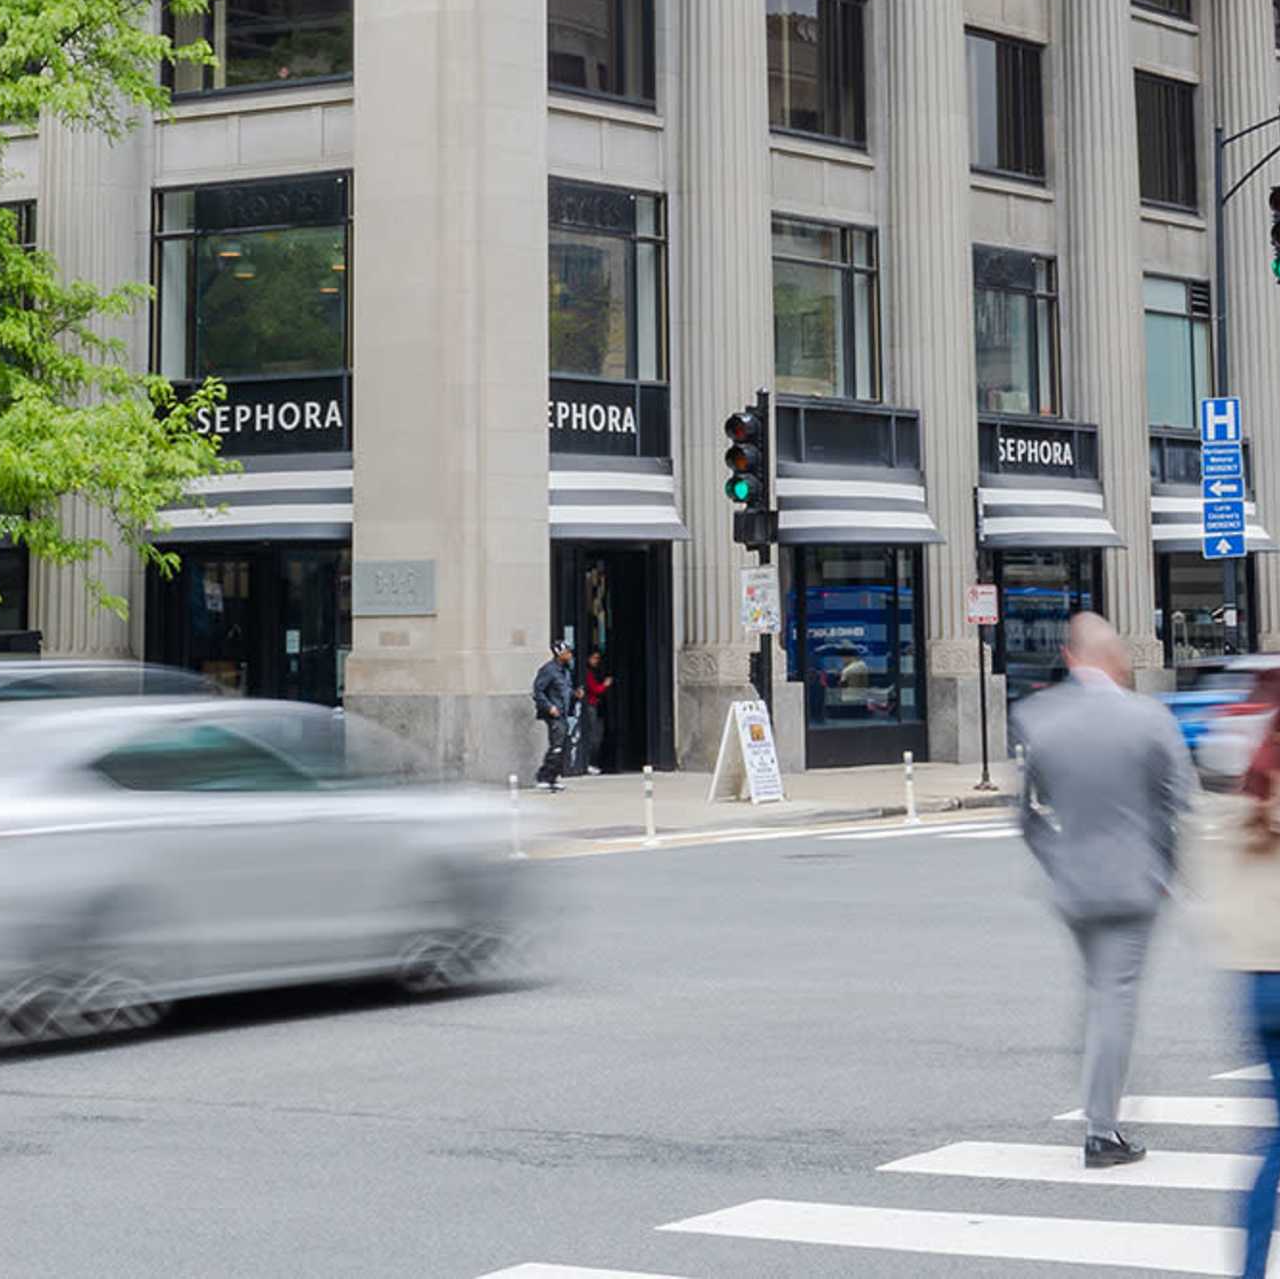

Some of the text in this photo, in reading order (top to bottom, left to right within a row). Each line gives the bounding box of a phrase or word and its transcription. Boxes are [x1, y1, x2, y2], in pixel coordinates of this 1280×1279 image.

[196, 400, 343, 434] SEPHORA
[548, 401, 637, 433] EPHORA
[1205, 401, 1236, 440] H
[997, 437, 1073, 466] SEPHORA
